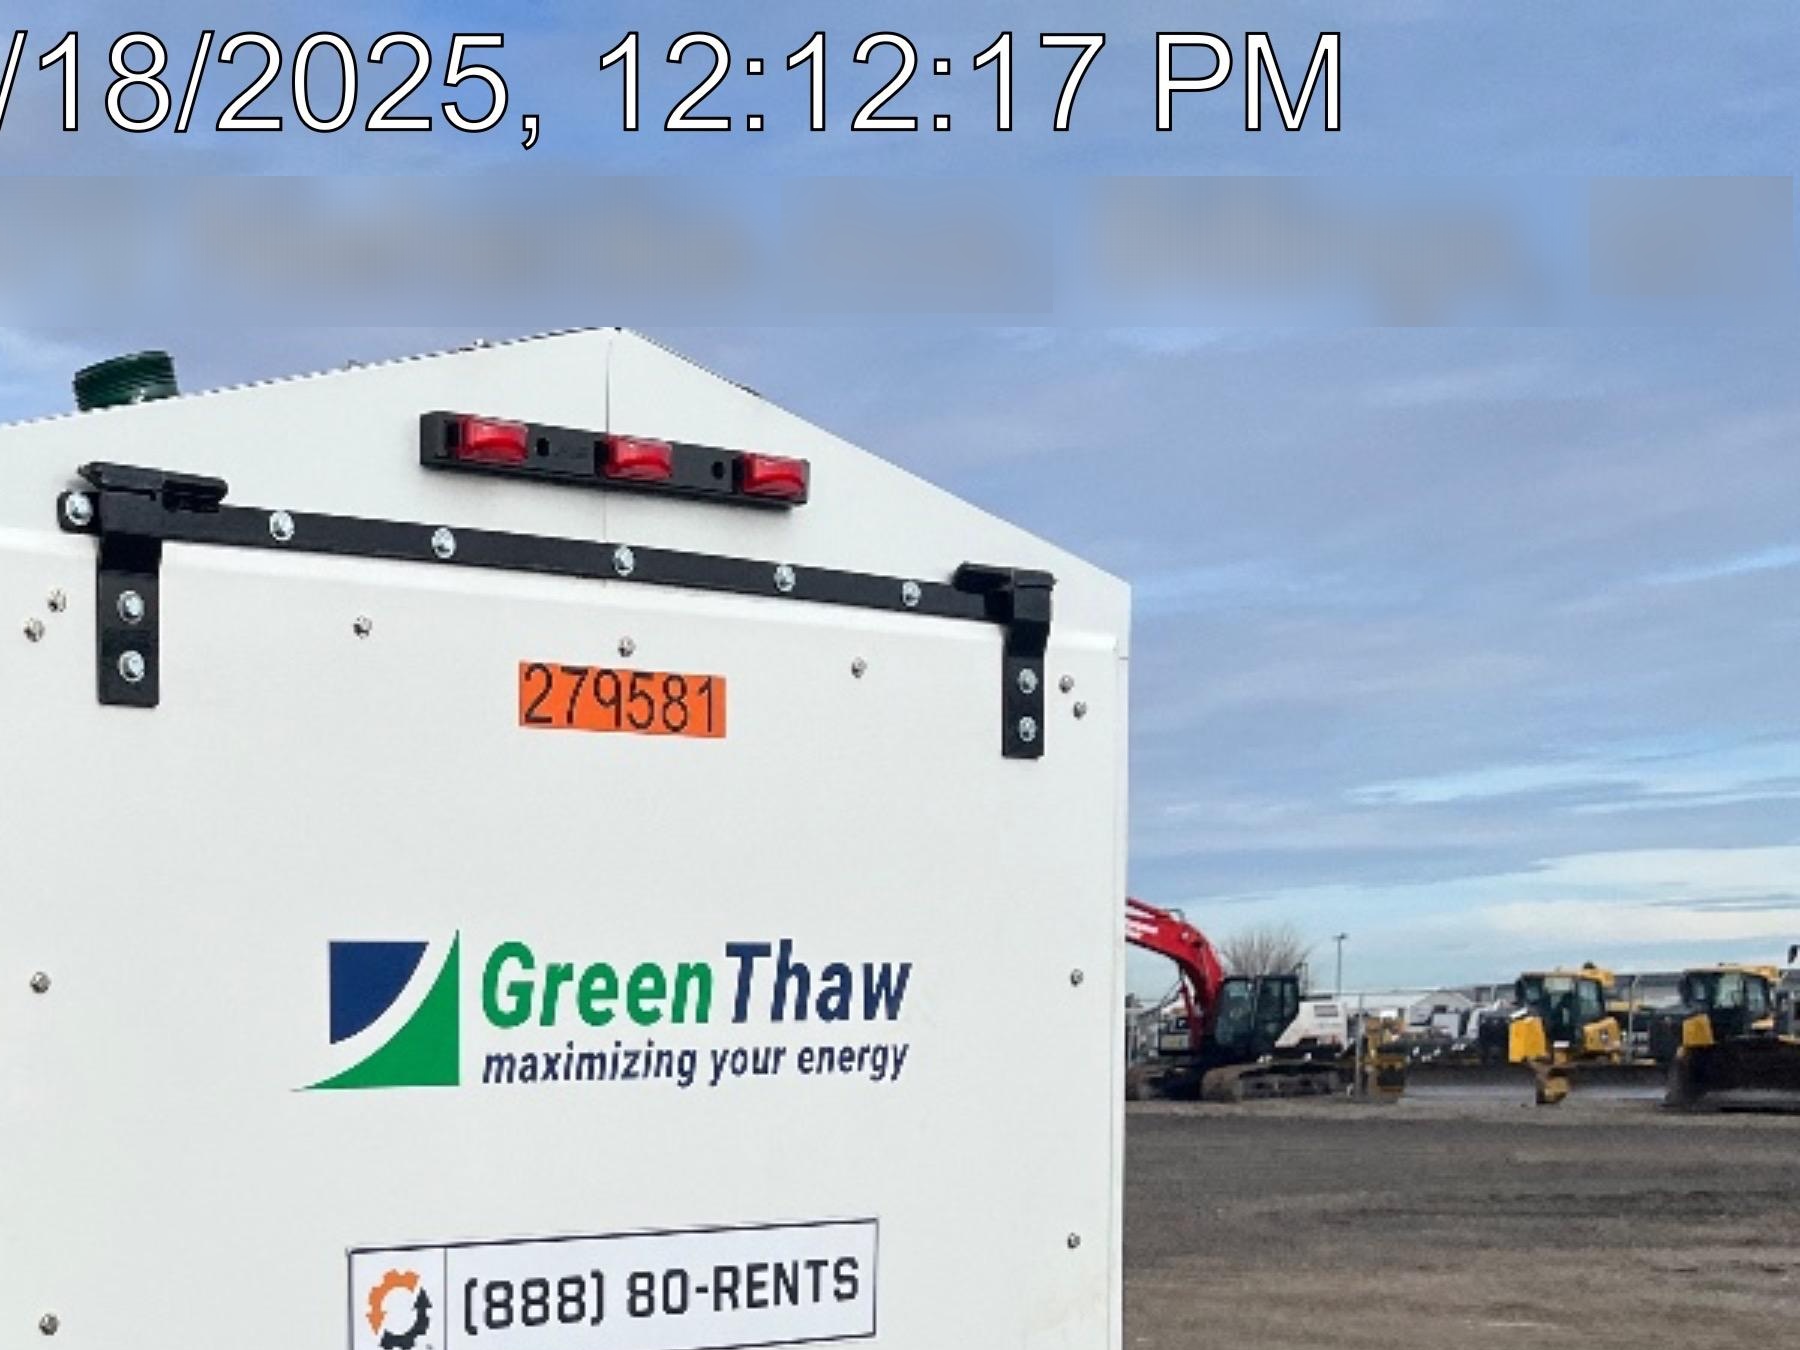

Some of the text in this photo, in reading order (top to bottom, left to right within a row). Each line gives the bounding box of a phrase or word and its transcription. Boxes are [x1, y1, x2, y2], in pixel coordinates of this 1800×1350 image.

[524, 662, 713, 733] 279581
[482, 1039, 910, 1088] maximizing your energy
[464, 1256, 861, 1336] (888) 80-RENTS
